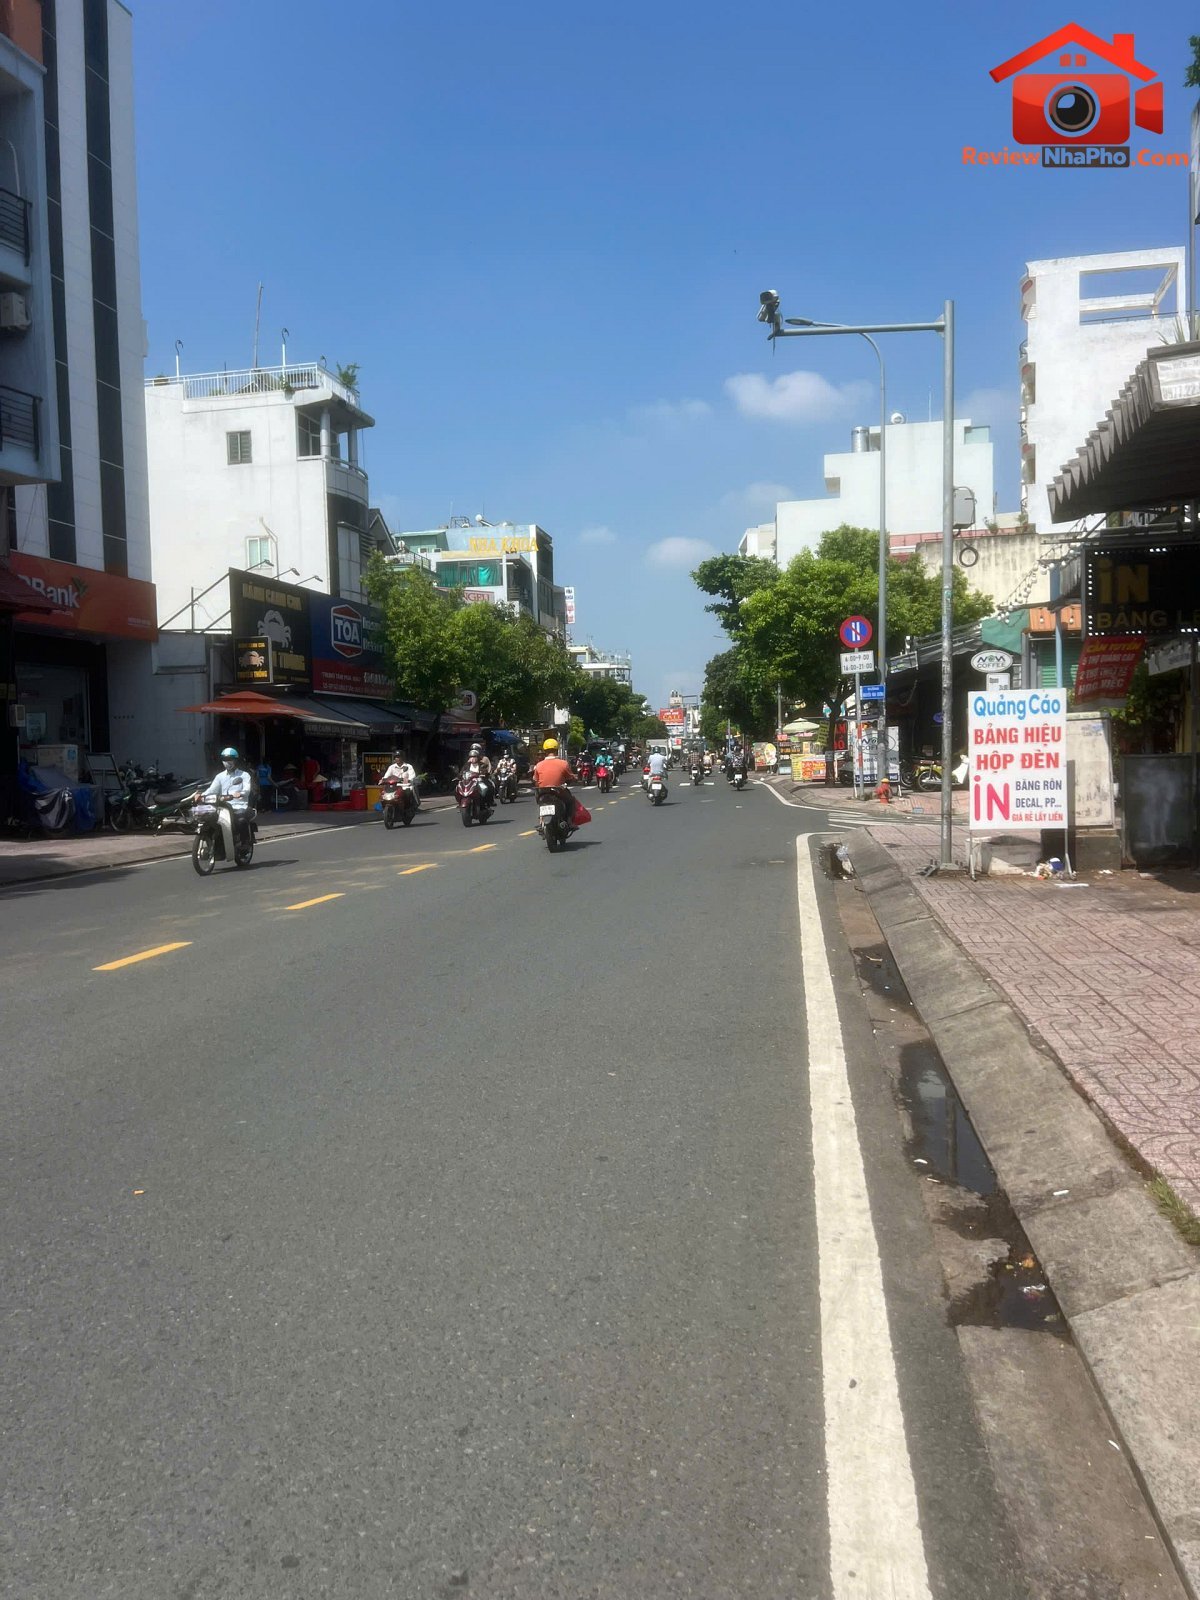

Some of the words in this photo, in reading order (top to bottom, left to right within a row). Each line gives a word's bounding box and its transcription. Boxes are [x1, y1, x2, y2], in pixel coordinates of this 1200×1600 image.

[470, 537, 497, 552] NHA
[501, 536, 539, 552] KHOA
[1096, 605, 1169, 630] BẢNG
[335, 618, 361, 645] TOA
[974, 694, 1026, 720] Quảng
[1029, 694, 1060, 715] Cáo
[974, 723, 1018, 745] BẢNG
[1024, 723, 1061, 747] HIỆU
[976, 751, 1014, 773] HỘP
[1020, 749, 1059, 769] ĐÈN
[1015, 779, 1040, 791] BĂNG
[1043, 778, 1062, 790] RÔN
[974, 775, 1010, 821] iN
[1015, 798, 1043, 808] DECAL,
[1011, 812, 1023, 822] GIÁ
[1034, 811, 1046, 821] LẤY
